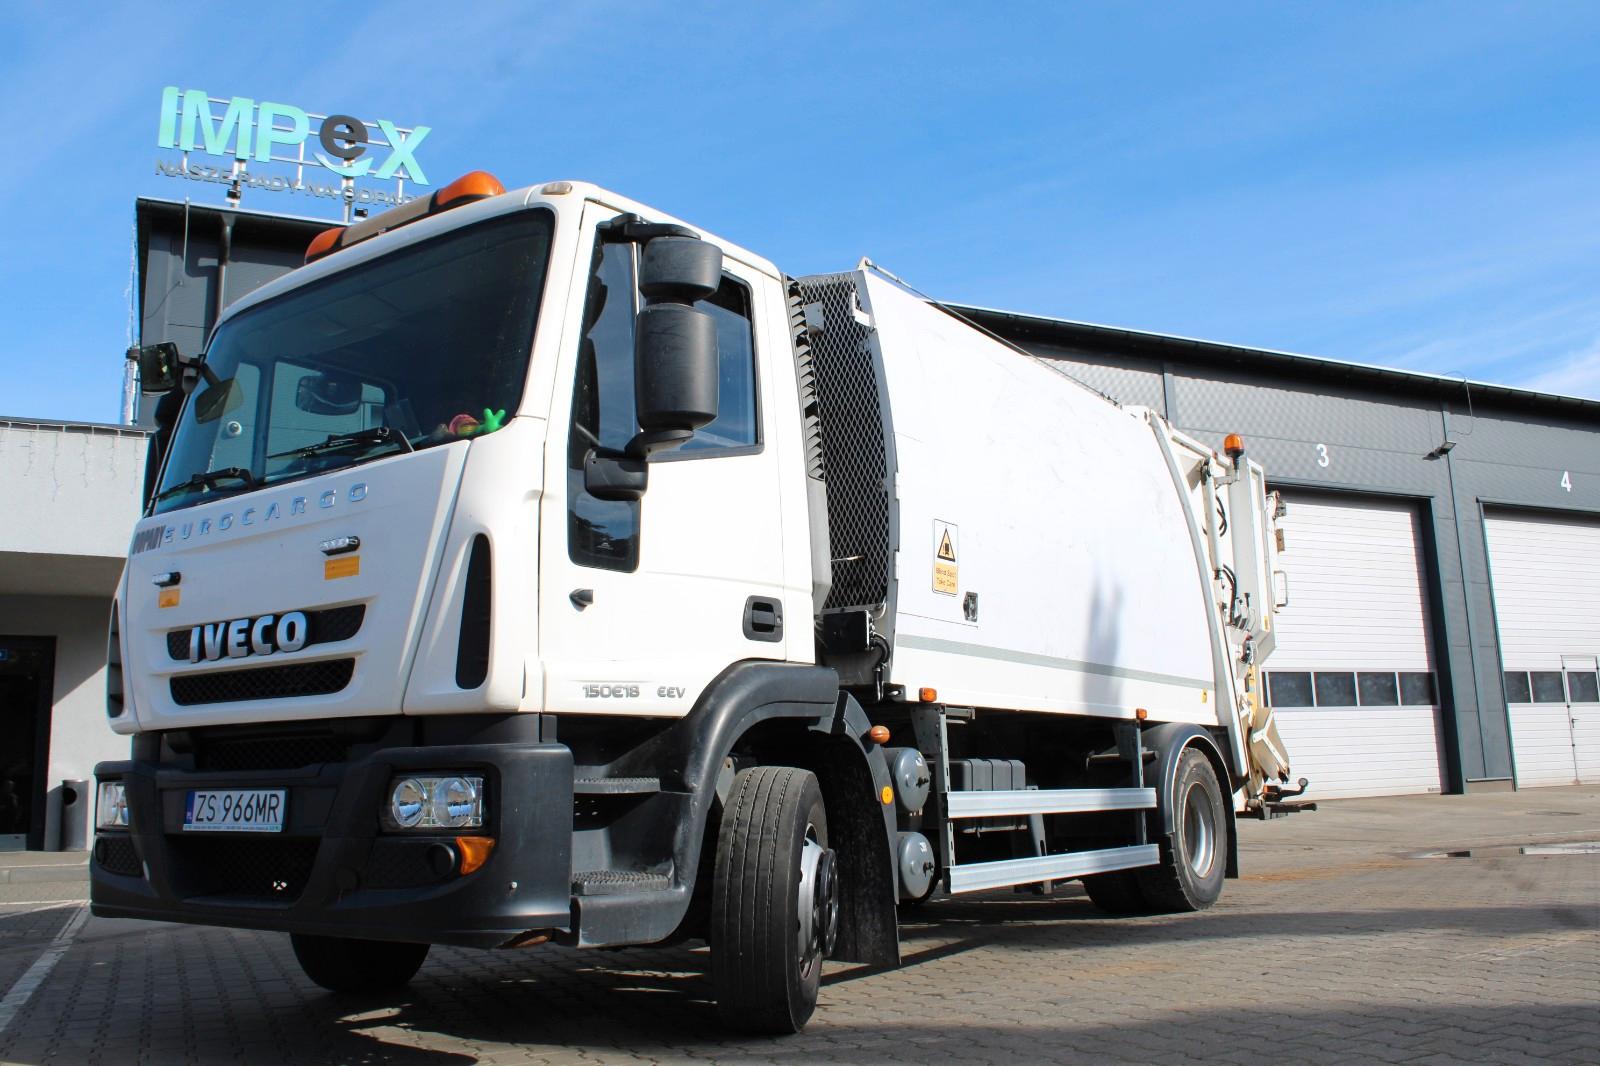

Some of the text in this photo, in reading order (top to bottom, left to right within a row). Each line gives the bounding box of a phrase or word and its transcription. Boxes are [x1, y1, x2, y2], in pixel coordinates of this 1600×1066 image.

[156, 159, 234, 184] NASZE
[238, 171, 300, 193] RADY
[304, 184, 337, 200] NA
[1316, 443, 1330, 468] 3
[1560, 471, 1572, 492] 4
[163, 482, 368, 543] EUROCARGO
[190, 611, 307, 664] IVECO
[582, 684, 686, 699] 150E18 EEV
[195, 793, 280, 823] ZS 966MR
